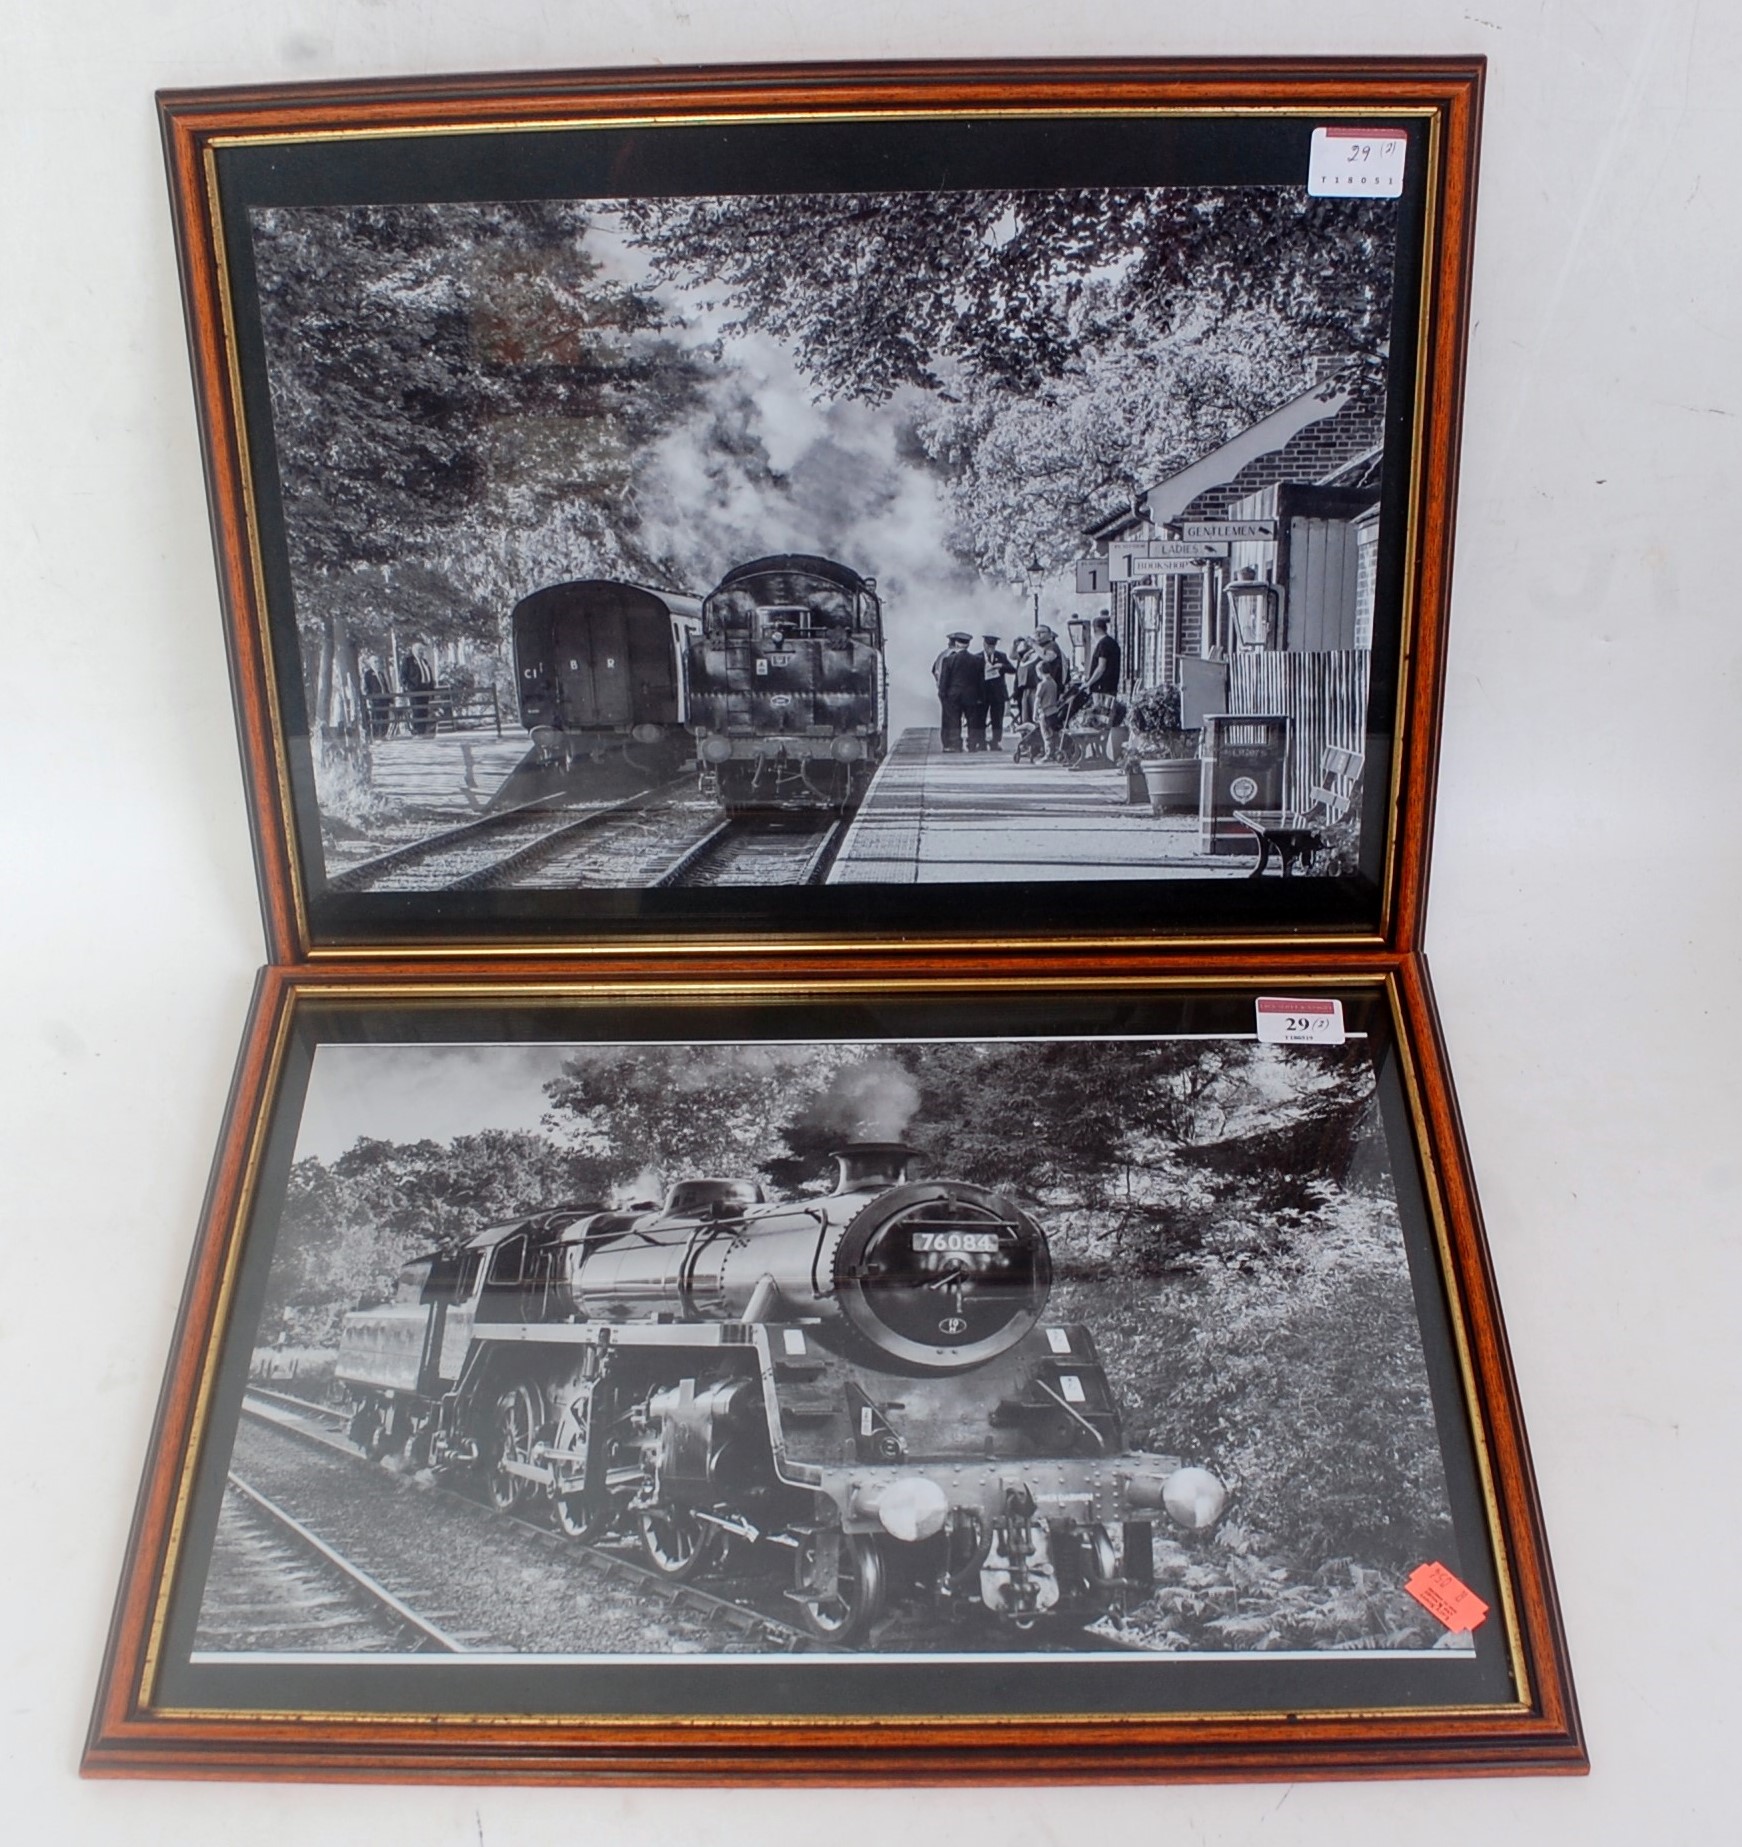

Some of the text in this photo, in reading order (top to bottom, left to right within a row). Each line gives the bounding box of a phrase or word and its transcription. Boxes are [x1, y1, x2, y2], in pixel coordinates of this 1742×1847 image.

[1347, 145, 1371, 162] 29
[1188, 524, 1256, 537] GENTLEMEN
[1162, 541, 1199, 555] LADIES
[1122, 554, 1133, 578] 1
[1088, 570, 1097, 591] 1
[569, 658, 615, 670] B R
[1286, 1017, 1310, 1032] 29
[922, 1234, 990, 1251] 76084
